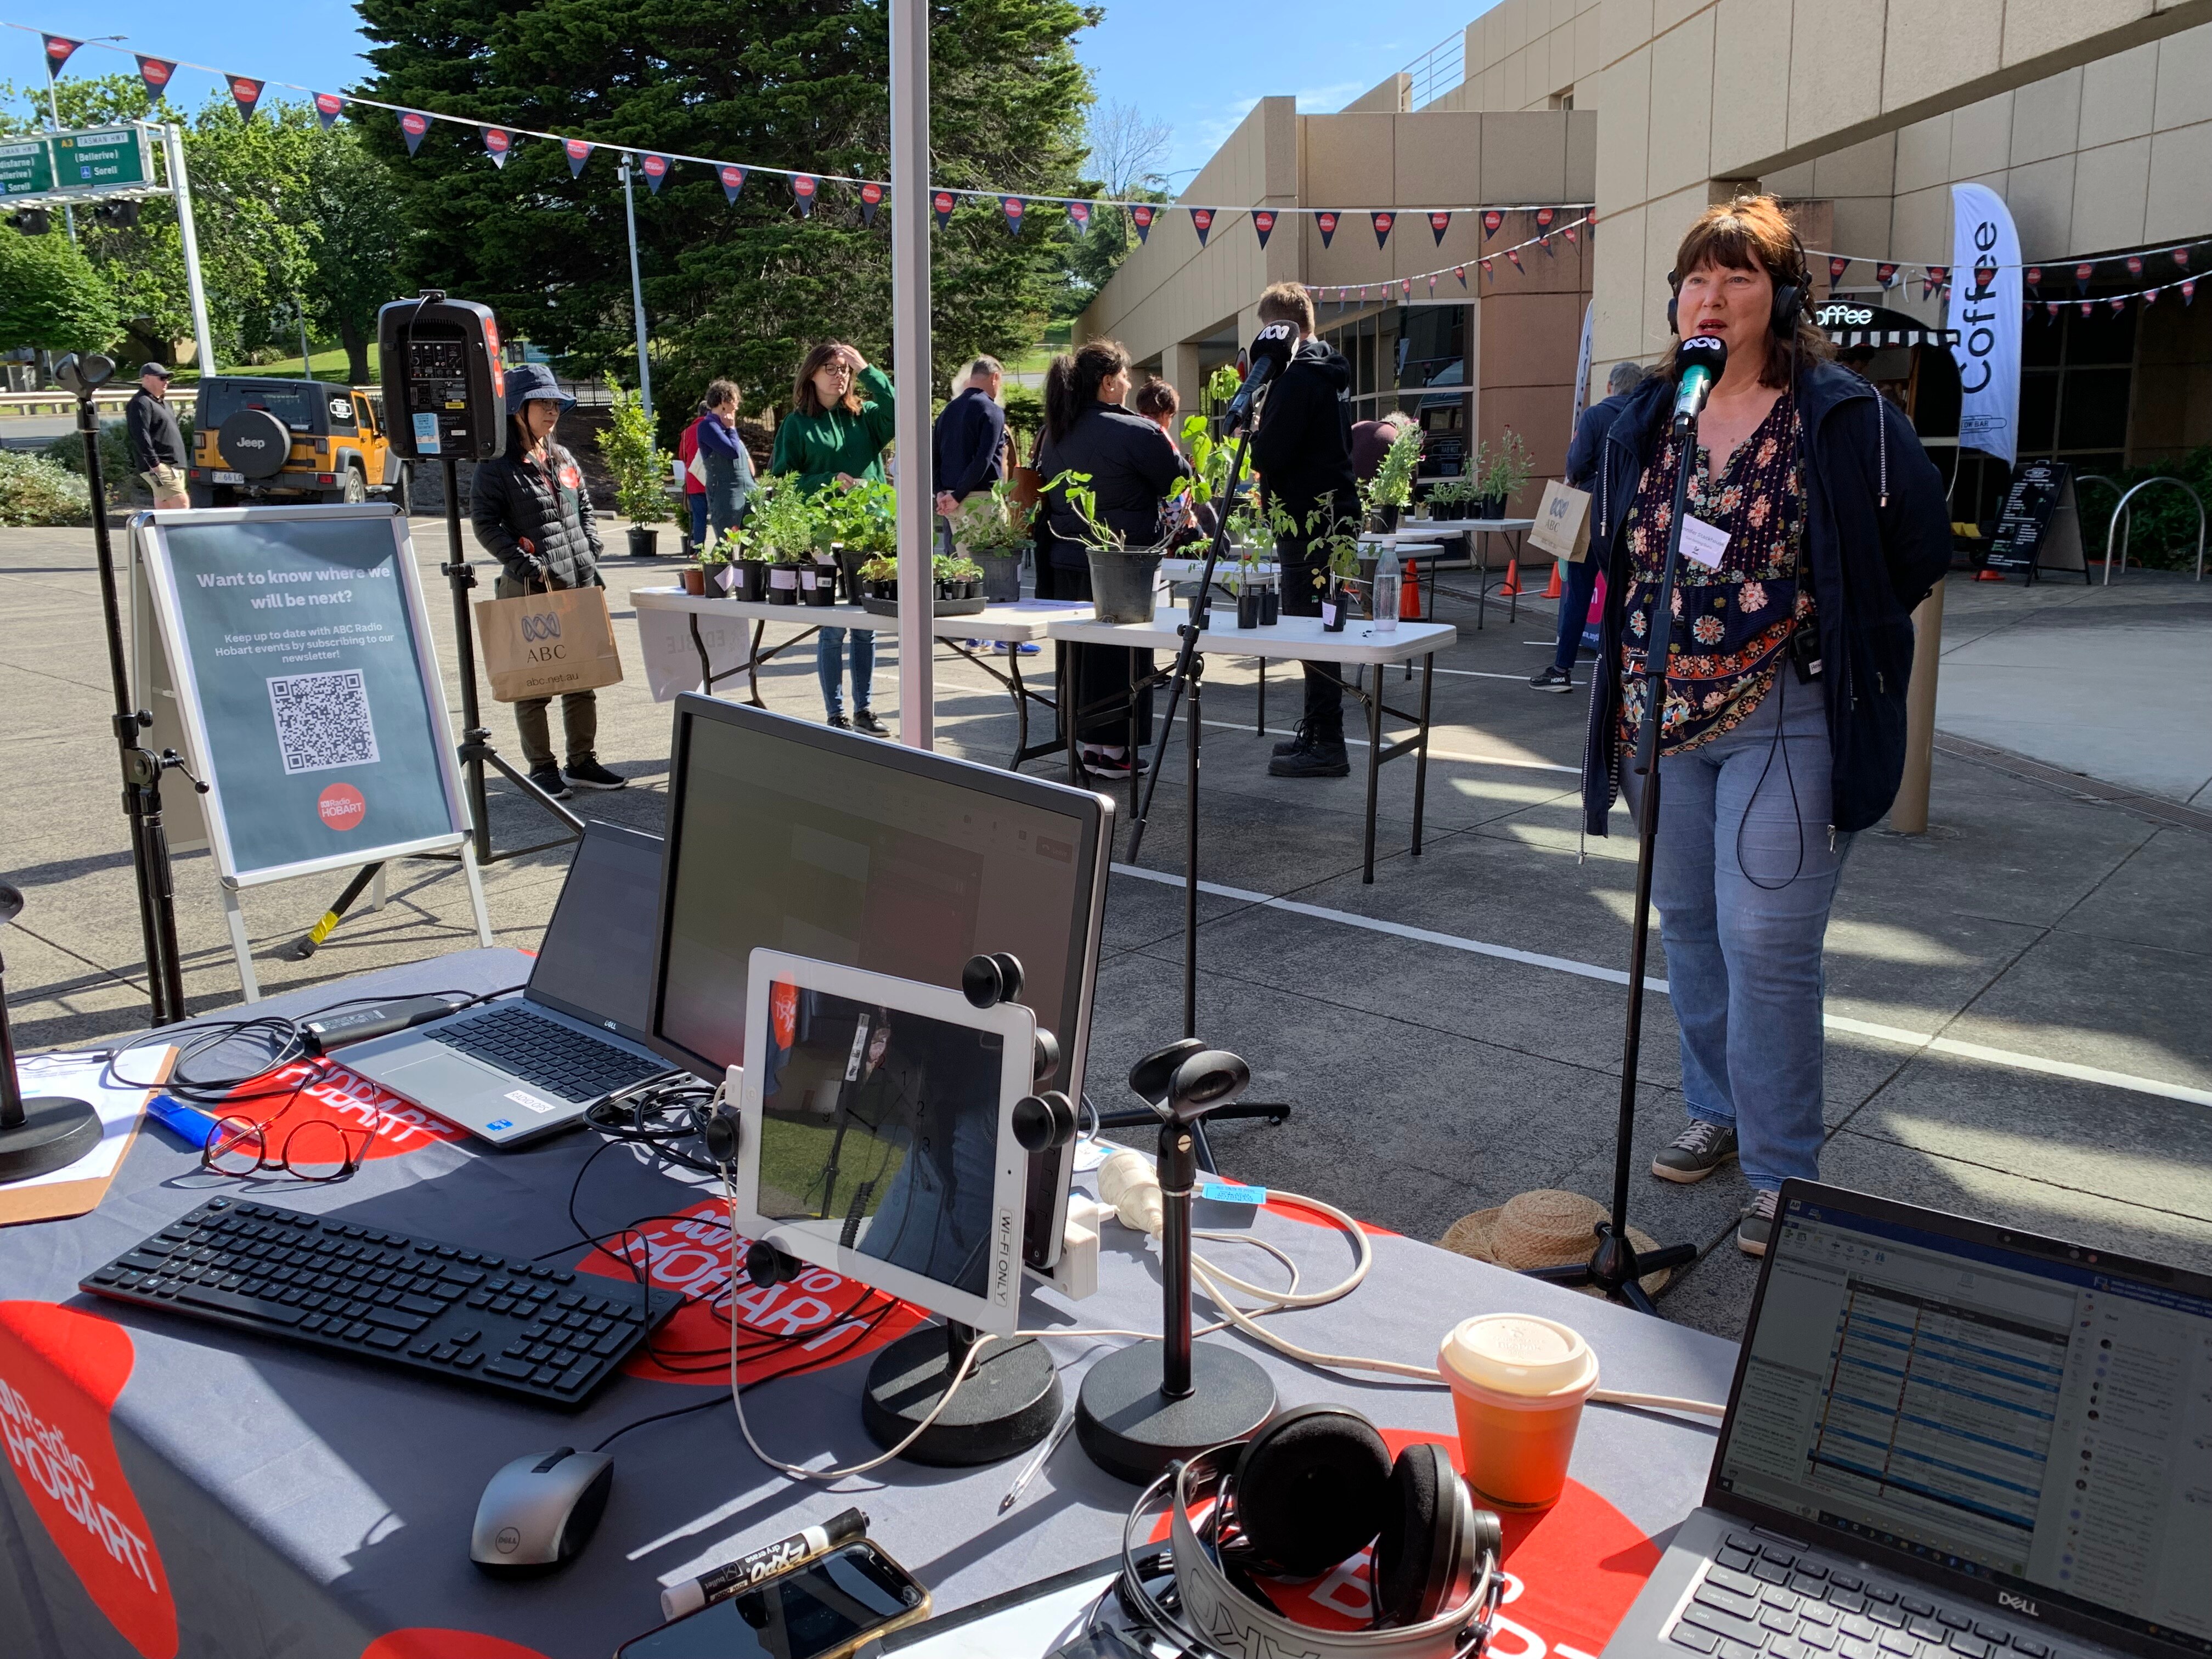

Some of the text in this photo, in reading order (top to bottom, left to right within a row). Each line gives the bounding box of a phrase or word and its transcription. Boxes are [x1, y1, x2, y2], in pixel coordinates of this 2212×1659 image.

[61, 134, 126, 148] A3 TASMAN HWY
[75, 149, 119, 162] (Bellerive)
[94, 166, 117, 176] Sorell
[8, 182, 31, 192] Sorell
[1816, 305, 1872, 326] offee
[1961, 221, 1997, 394] Coffee
[236, 437, 266, 449] Jeep
[1545, 518, 1561, 533] ABC
[196, 567, 391, 588] Want to know where we
[250, 590, 352, 609] will be next?
[224, 623, 382, 644] Keep up to date with ABC Radio
[215, 645, 253, 657] Hobart
[255, 644, 291, 653] events
[291, 641, 305, 651] by
[307, 636, 365, 650] subscribing
[366, 636, 377, 644] to
[526, 644, 567, 663] ABC
[281, 650, 340, 663] newsletter!
[526, 672, 579, 687] abc.net.au
[321, 803, 362, 817] HOBART
[329, 798, 351, 806] Radio
[604, 1020, 616, 1030] DELL
[509, 1092, 549, 1112] RADIO OPS
[997, 1216, 1011, 1302] WI-FI ONLY
[613, 1231, 873, 1352] HOBART
[11, 1387, 95, 1492] Radio
[0, 1410, 158, 1594] HOBART
[744, 1544, 781, 1564] dry erase
[751, 1542, 806, 1583] EXPO
[705, 1576, 726, 1589] bullet
[1997, 1591, 2039, 1617] DELL
